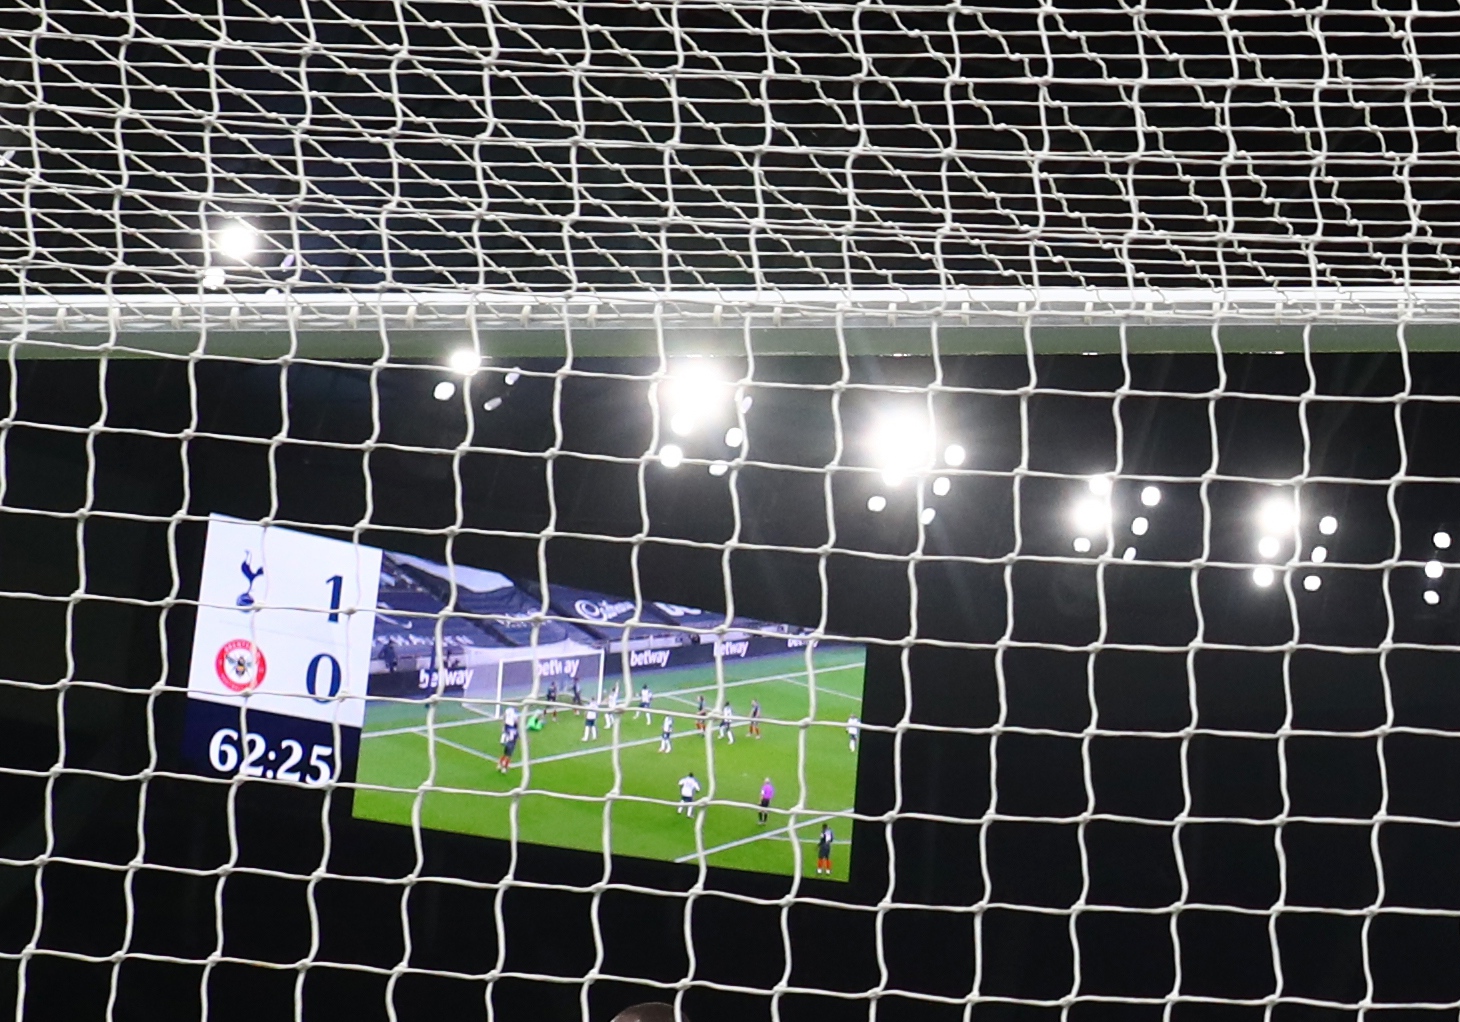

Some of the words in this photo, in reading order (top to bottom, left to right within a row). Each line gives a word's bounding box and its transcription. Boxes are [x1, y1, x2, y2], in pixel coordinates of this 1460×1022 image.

[326, 575, 343, 624] 1
[305, 653, 342, 704] 0
[630, 649, 671, 668] betway
[208, 728, 333, 787] 62:25
